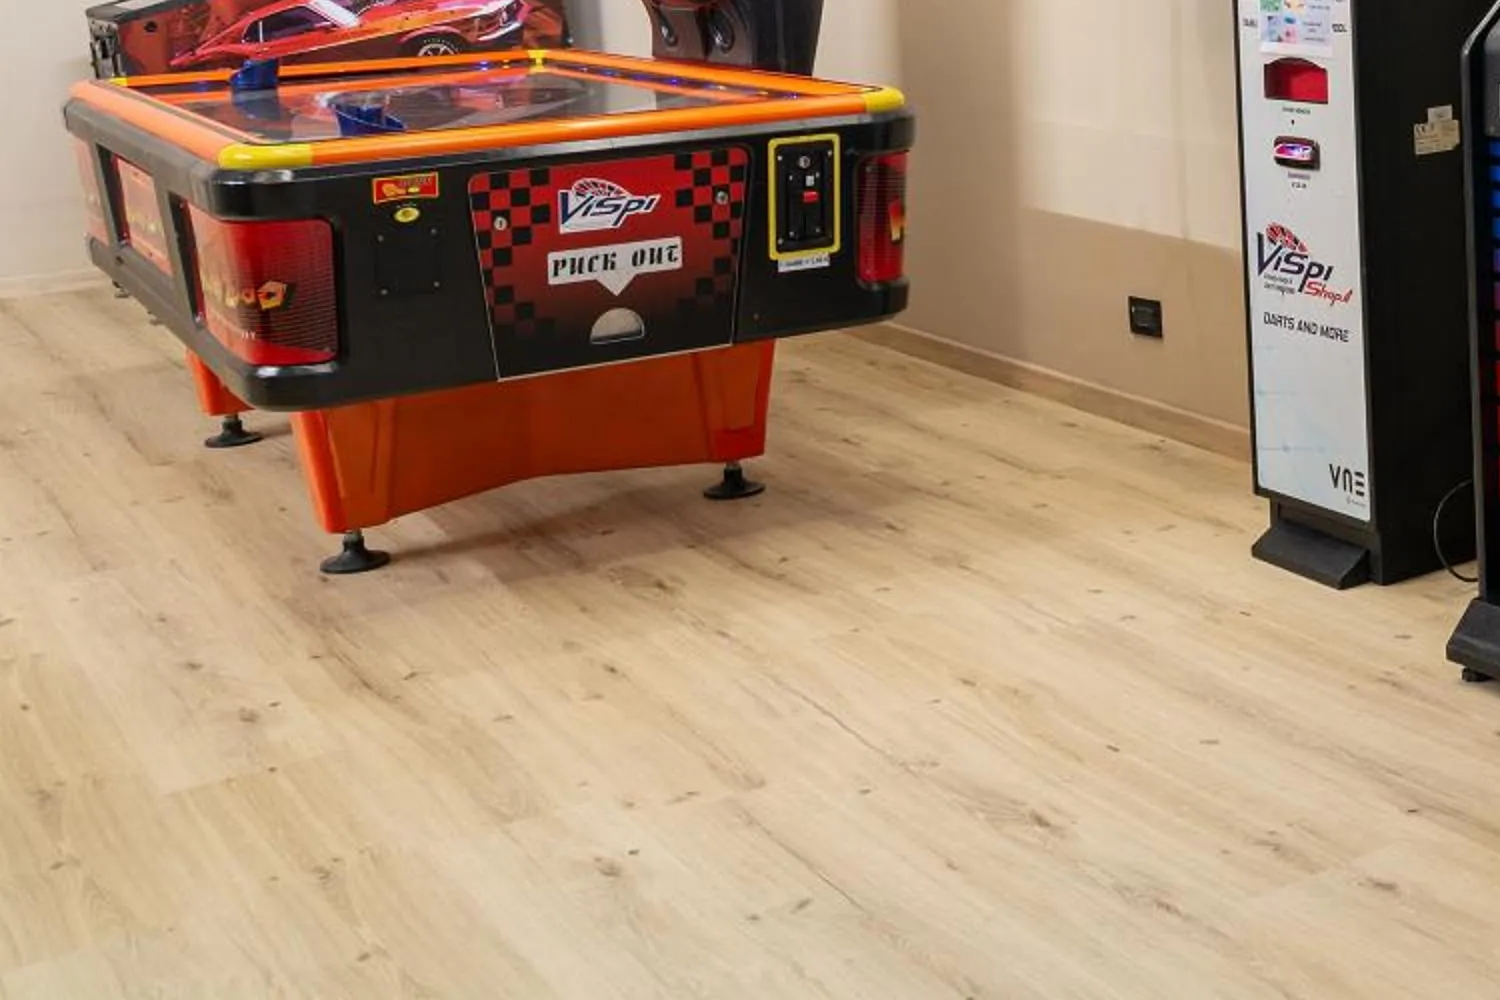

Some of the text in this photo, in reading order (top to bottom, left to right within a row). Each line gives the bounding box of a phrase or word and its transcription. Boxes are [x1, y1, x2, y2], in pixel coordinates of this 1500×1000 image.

[552, 244, 680, 277] PUCK OUT
[1263, 311, 1350, 343] DARTS AND MORE
